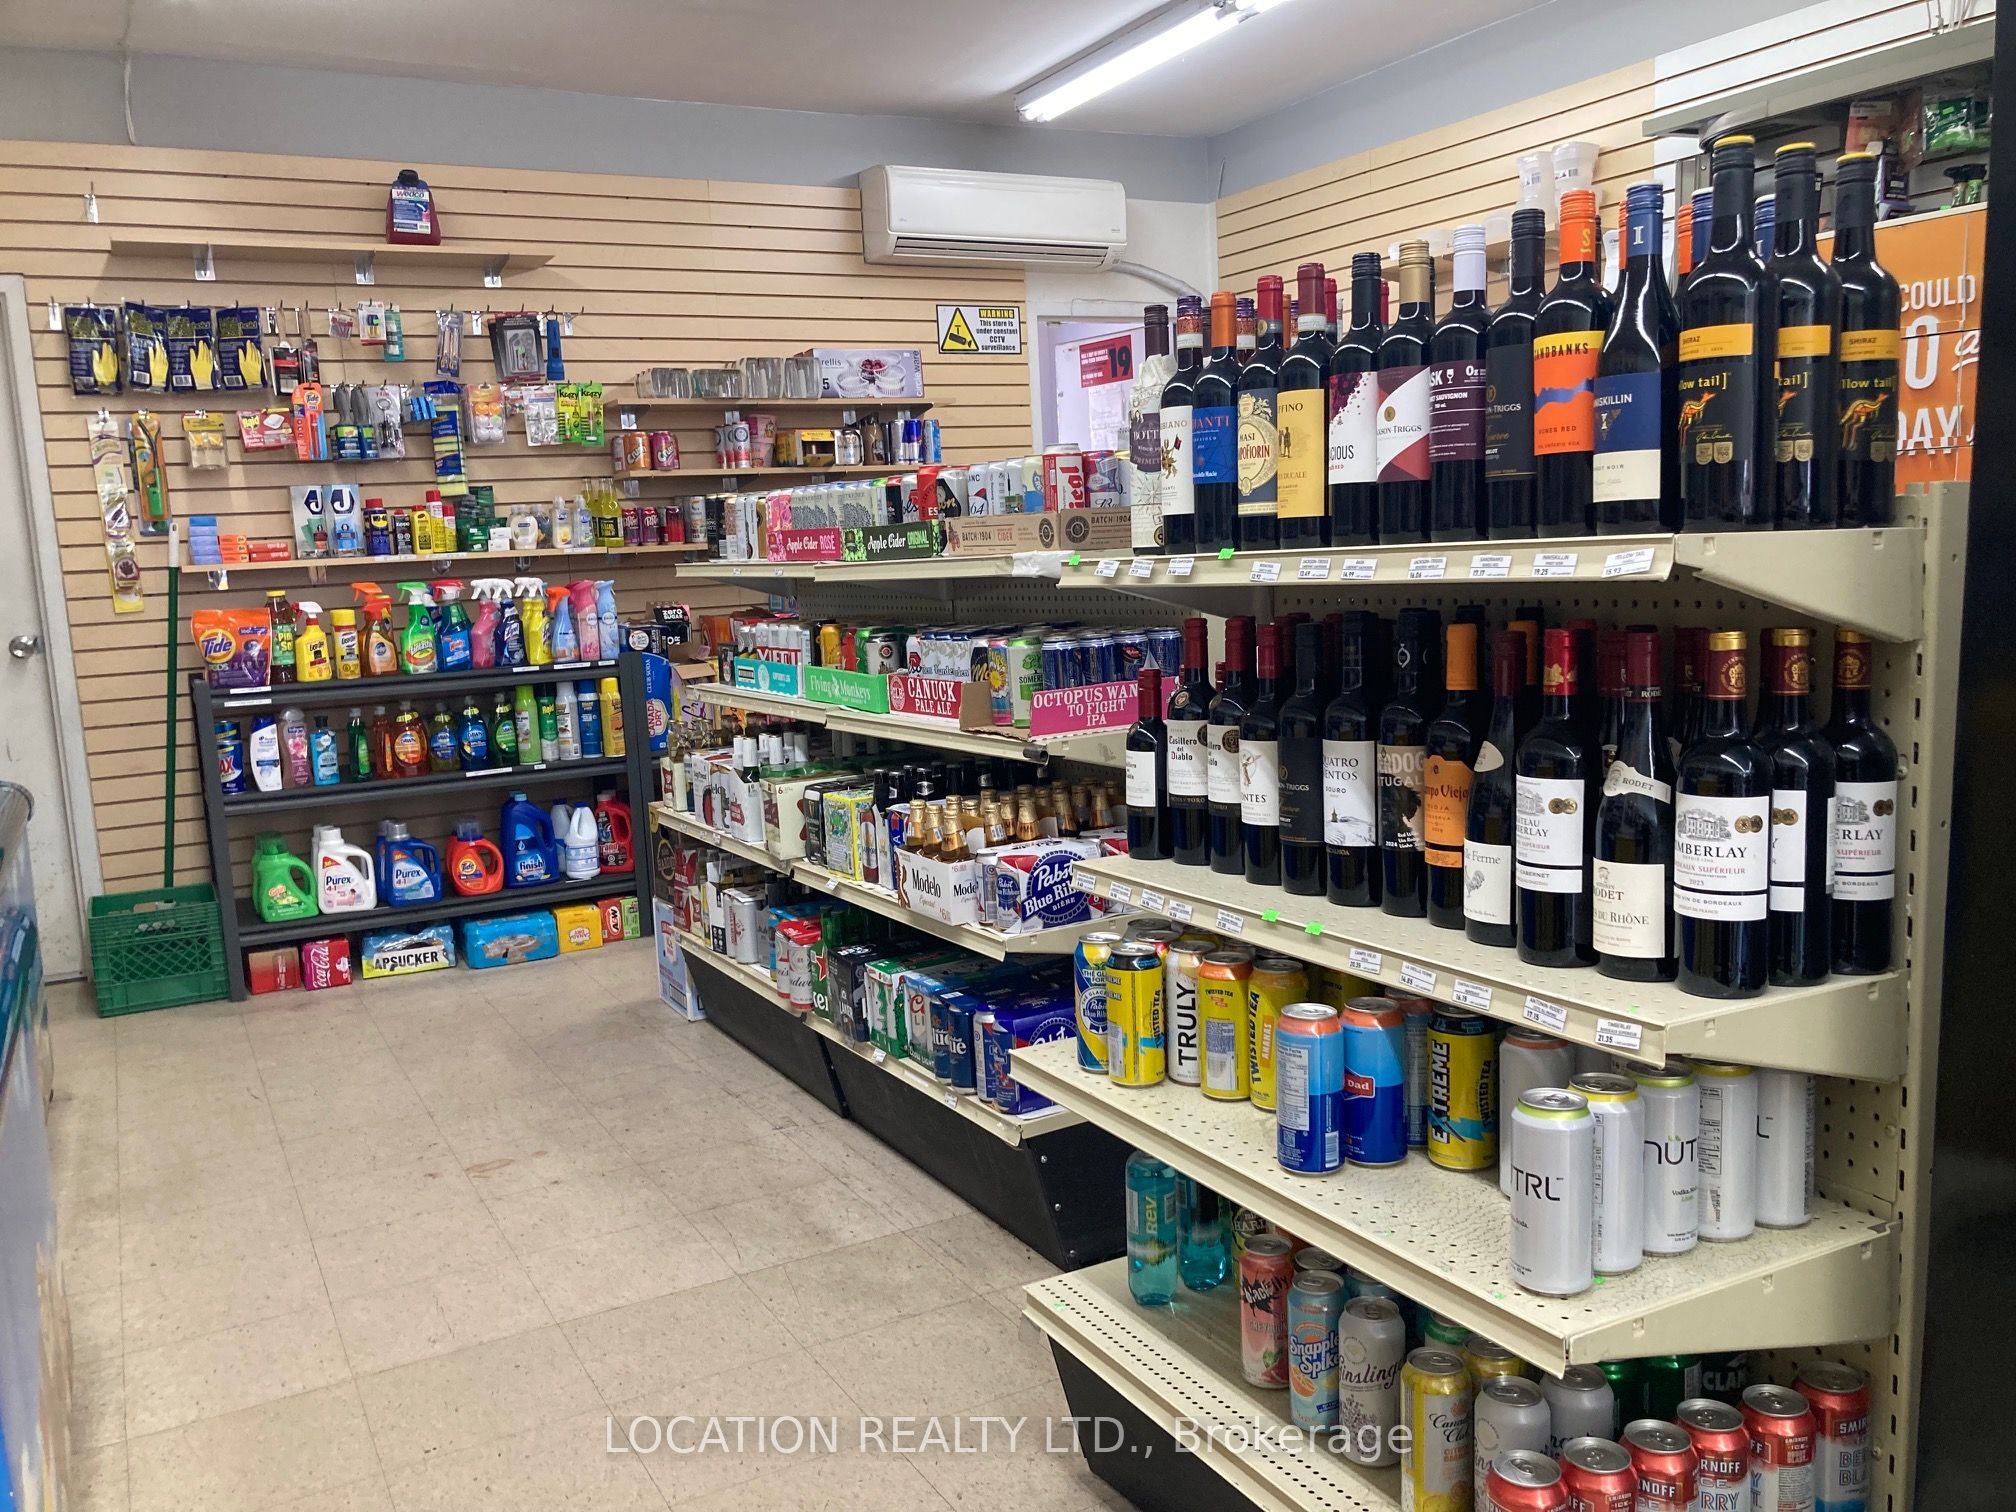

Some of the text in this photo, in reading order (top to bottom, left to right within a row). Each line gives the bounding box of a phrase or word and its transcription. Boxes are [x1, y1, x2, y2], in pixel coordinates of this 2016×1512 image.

[980, 309, 1014, 318] WARNING
[1849, 337, 1877, 345] SHIRAZ
[1109, 346, 1131, 378] 19
[1436, 392, 1468, 401] SAUVIGNON
[786, 534, 836, 552] Apple Cider ROSÉ
[867, 529, 928, 550] Apple Cider ORIGINAL
[998, 531, 1013, 542] CIDER
[1534, 568, 1549, 576] 19.25
[201, 637, 233, 658] Tide
[281, 642, 292, 651] SO
[810, 673, 833, 694] Flying
[840, 679, 871, 704] Monkeys
[908, 679, 957, 703] CANUCK
[1033, 688, 1104, 709] OCTOPUS
[915, 699, 952, 715] PALE ALE
[1067, 699, 1126, 717] TO FIGHT
[646, 698, 656, 737] CANADA
[655, 709, 663, 727] DRY
[1086, 715, 1107, 726] IPA
[1171, 751, 1193, 761] Diablo
[219, 756, 234, 773] AX
[1324, 771, 1358, 781] ENTOS
[1622, 777, 1654, 791] RODET
[1471, 850, 1501, 865] Ferme
[1836, 848, 1882, 857] SUPÉRIEUR
[395, 868, 421, 879] Purex
[461, 862, 475, 873] Tide
[519, 859, 543, 873] finish
[1520, 869, 1550, 878] CABERNET
[1698, 864, 1746, 875] SUPÉRIEUR
[325, 875, 351, 886] Purex
[1034, 860, 1073, 890] Pabst
[1689, 878, 1705, 886] 2023
[911, 869, 942, 898] Modelo
[1023, 893, 1054, 917] Blue
[1052, 898, 1076, 912] BIÈRE
[1703, 899, 1743, 907] BORDEAUX
[1610, 910, 1649, 925] RHÔNE
[1154, 990, 1162, 1007] TEA
[1205, 989, 1234, 998] TWISTED TEA
[1529, 998, 1548, 1009] ANTONIN
[1549, 1005, 1564, 1015] RODET
[1526, 1010, 1540, 1021] 17.15
[1176, 982, 1198, 1066] TRULY
[932, 1027, 950, 1046] lue
[1248, 990, 1261, 1085] TWISTED TEA
[1261, 1023, 1273, 1060] ANANAS
[1597, 1034, 1614, 1043] 21.35
[949, 1040, 967, 1055] ue
[1482, 1059, 1492, 1081] TEA
[1347, 1079, 1370, 1091] Dad
[1512, 1166, 1561, 1202] TRL
[1146, 1196, 1158, 1235] Rev
[1244, 1281, 1270, 1303] black
[1290, 1331, 1340, 1355] Snapple
[1299, 1353, 1340, 1378] Spike
[1700, 1458, 1741, 1474] RNOFF
[1700, 1479, 1729, 1489] CE
[1701, 1491, 1740, 1512] RRY
